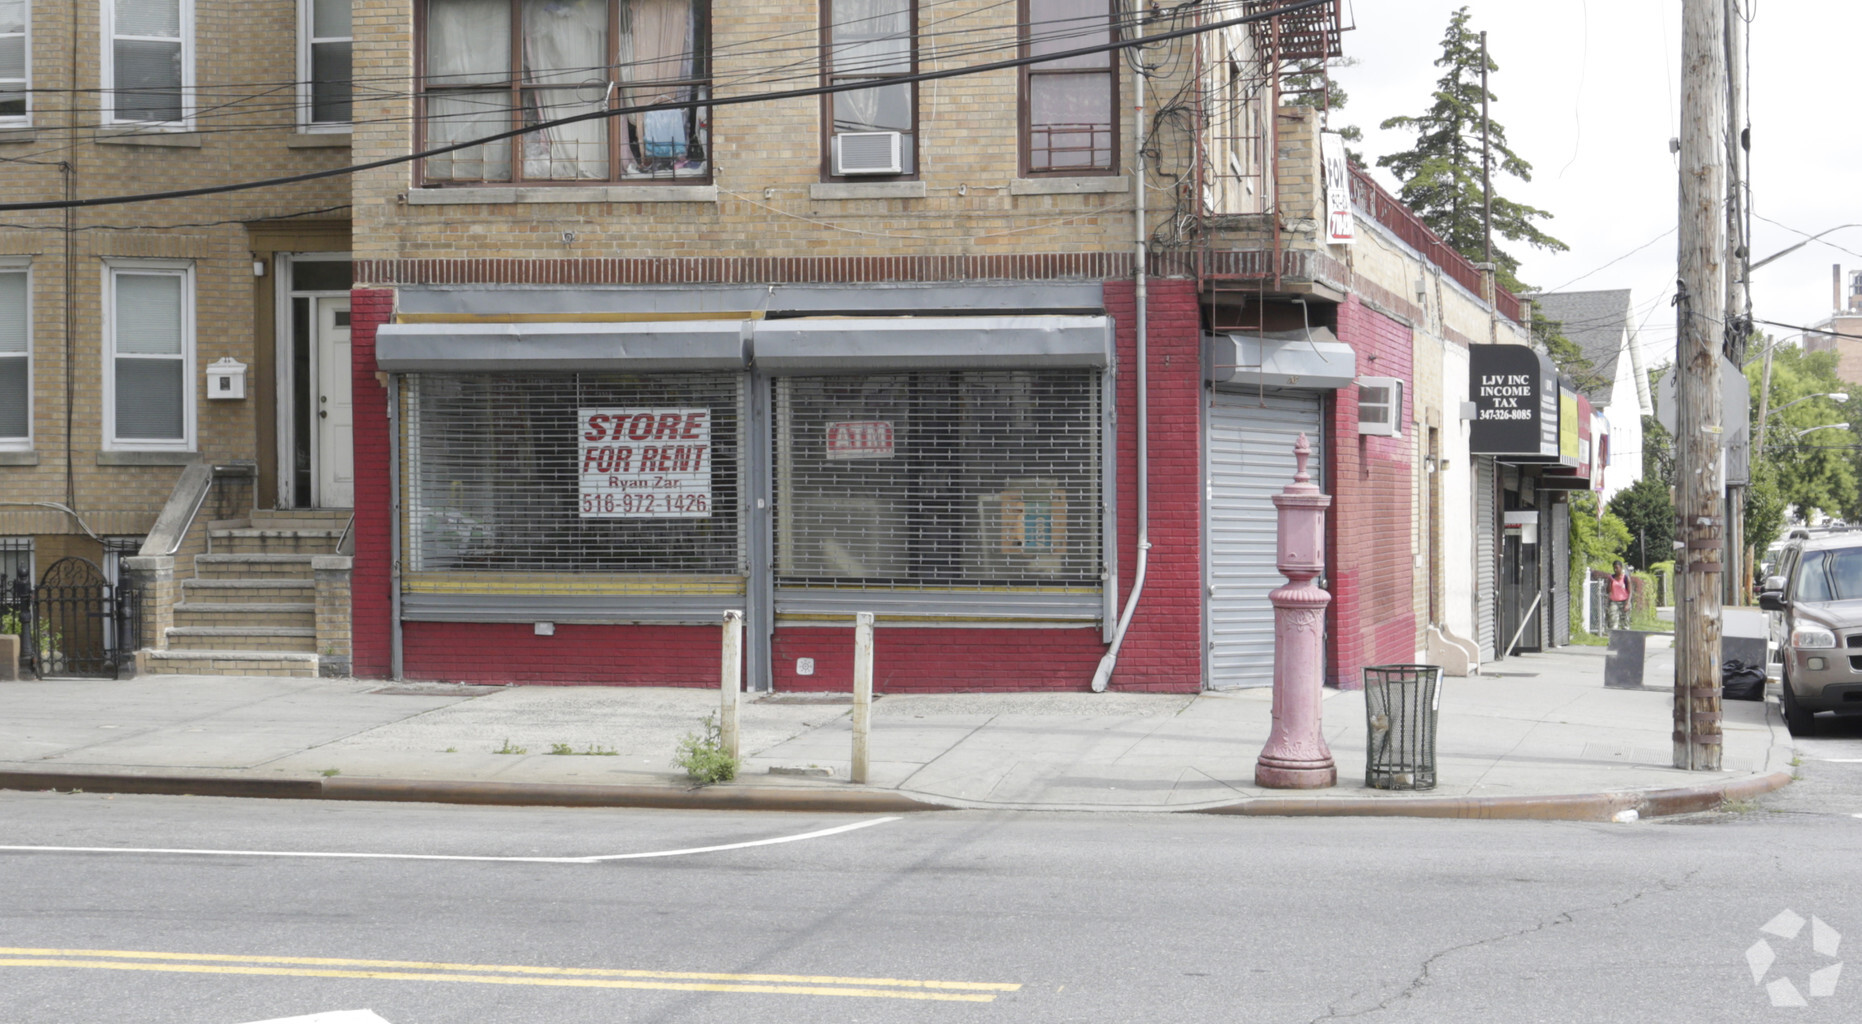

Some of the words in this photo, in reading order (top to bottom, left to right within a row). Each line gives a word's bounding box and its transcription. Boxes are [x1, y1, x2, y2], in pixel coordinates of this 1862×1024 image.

[1482, 375, 1505, 385] LJV
[1508, 375, 1530, 385] INC
[1480, 386, 1531, 396] INCOME
[1493, 398, 1518, 408] TAX
[1479, 409, 1532, 420] 347-326-8085
[584, 412, 707, 441] STORE
[835, 424, 886, 449] ATM
[583, 445, 633, 473] FOR
[640, 444, 708, 472] RENT
[609, 476, 648, 491] Ryan
[582, 493, 707, 513] 516-972-1426
